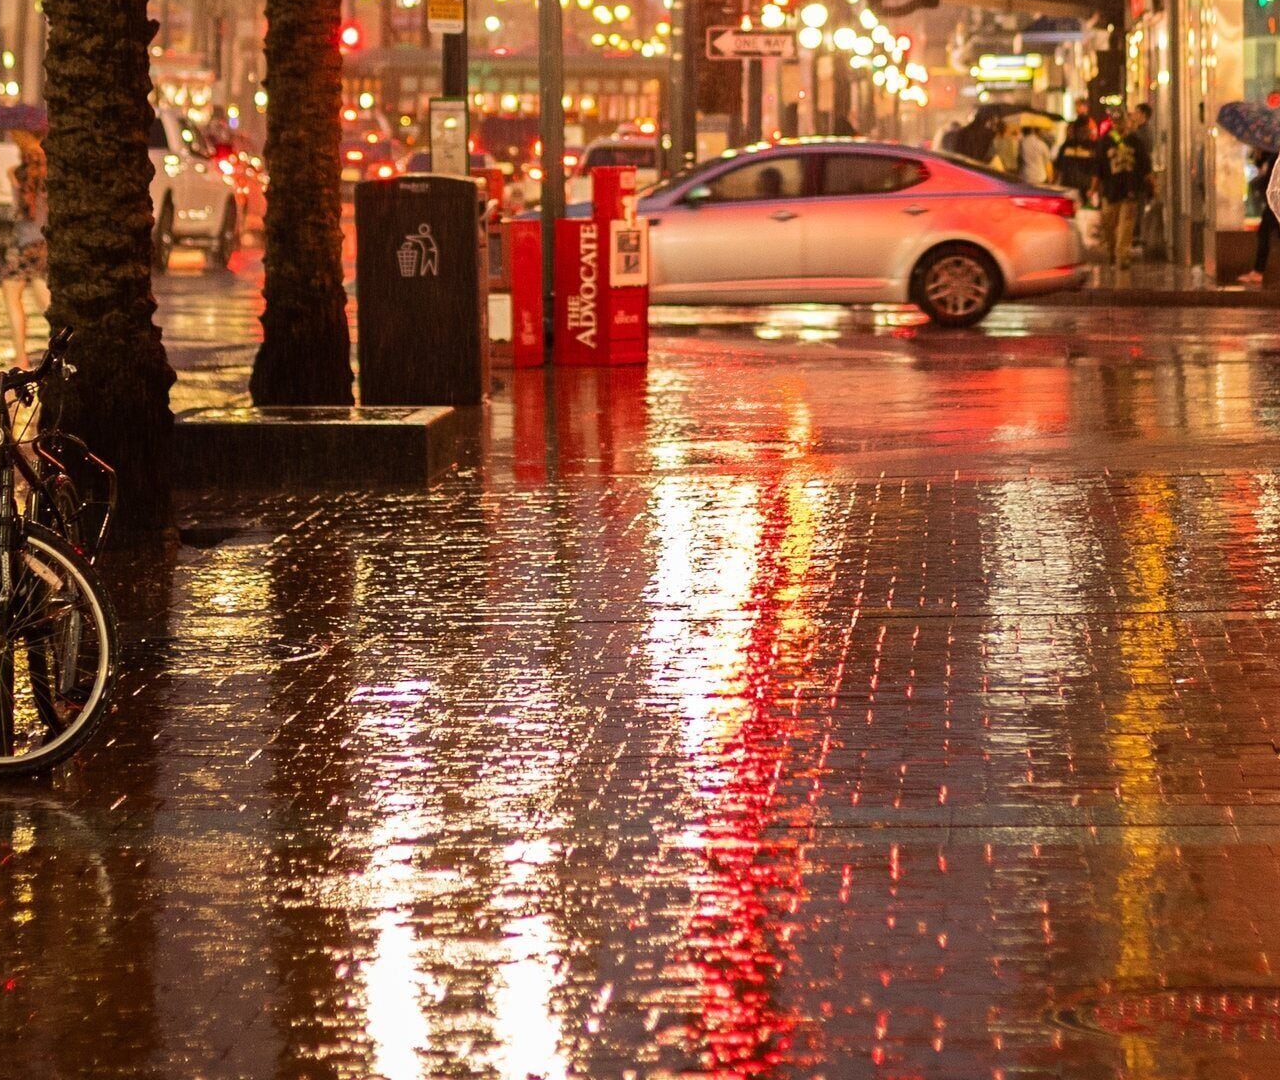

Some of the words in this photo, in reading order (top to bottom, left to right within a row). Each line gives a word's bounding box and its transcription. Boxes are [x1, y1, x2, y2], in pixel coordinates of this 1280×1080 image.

[734, 37, 759, 49] ONE
[764, 37, 787, 48] WAY
[576, 223, 599, 350] ADVOCATE
[567, 294, 581, 331] THE
